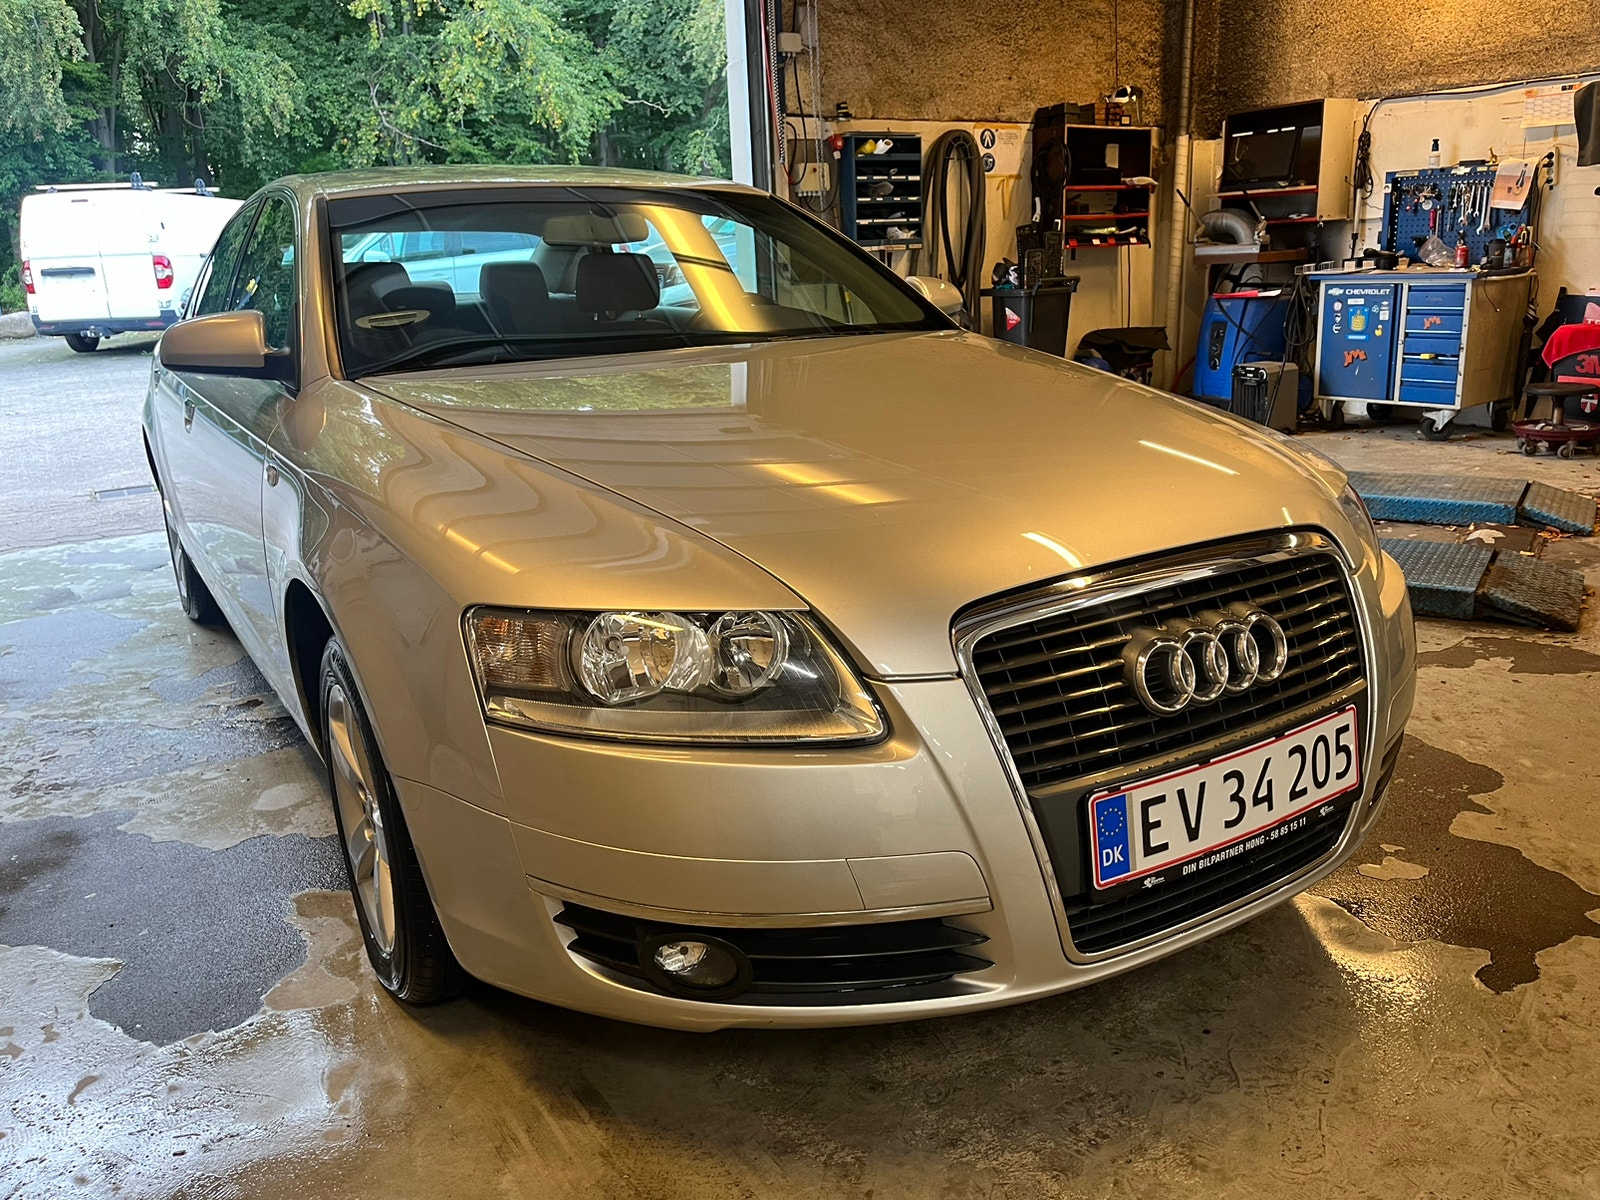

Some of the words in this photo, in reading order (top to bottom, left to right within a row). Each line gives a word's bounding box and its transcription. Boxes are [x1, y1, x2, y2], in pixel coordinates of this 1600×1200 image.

[1140, 781, 1206, 858] EV
[1222, 756, 1274, 829] 34
[1287, 723, 1352, 802] 205
[1102, 844, 1125, 867] DK
[1182, 861, 1197, 876] DIN
[1198, 844, 1244, 870] BILPARTNER
[1270, 830, 1279, 841] 58
[1290, 820, 1298, 831] 15
[1299, 816, 1307, 828] 11
